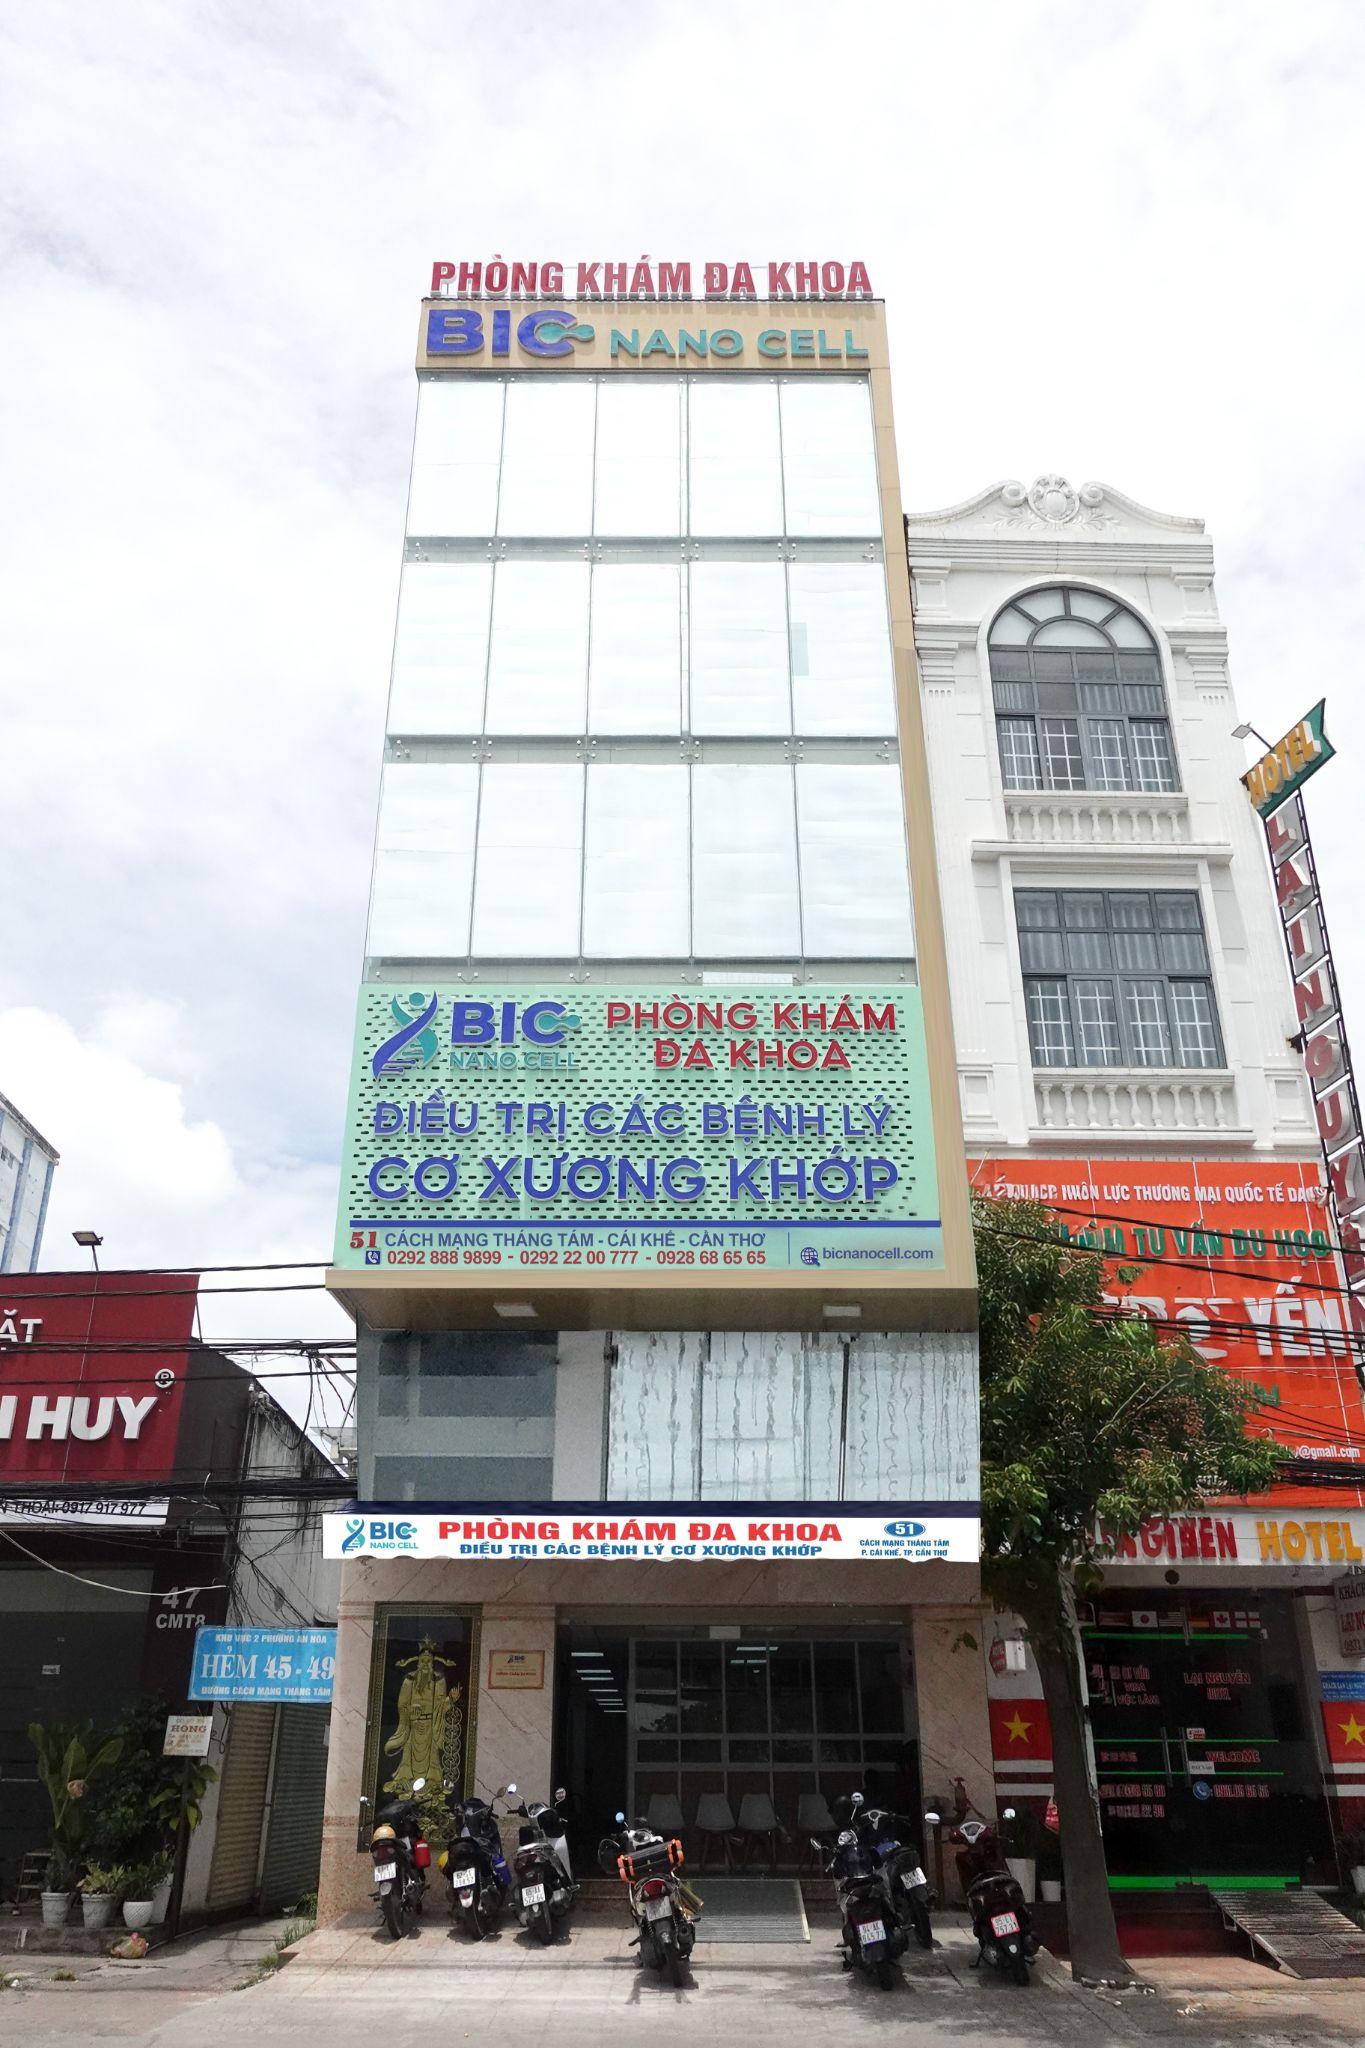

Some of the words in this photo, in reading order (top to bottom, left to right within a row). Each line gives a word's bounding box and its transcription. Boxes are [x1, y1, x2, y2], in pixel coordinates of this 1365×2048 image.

[430, 254, 564, 297] PHÒNG
[576, 254, 692, 298] KHÁM
[704, 262, 757, 298] ĐA
[768, 261, 873, 298] KHOA
[426, 309, 577, 357] BIC
[610, 329, 743, 357] NANO
[758, 329, 868, 358] CELL
[1247, 720, 1322, 808] HOTEL
[451, 1001, 568, 1047] BIC
[607, 994, 758, 1032] PHÒNG
[774, 994, 895, 1032] KHÁM
[450, 1052, 518, 1070] NANO
[524, 1052, 579, 1070] CELL
[653, 1038, 716, 1069] ĐA
[729, 1039, 852, 1070] KHOA
[374, 1088, 478, 1136] ĐIỀU
[495, 1103, 567, 1143] TRỊ
[583, 1093, 686, 1136] CÁC
[702, 1094, 825, 1145] BỆNH
[843, 1094, 892, 1137] LÝ
[368, 1153, 460, 1200] CƠ
[479, 1152, 706, 1201] XƯƠNG
[729, 1145, 898, 1202] KHỚP
[1103, 1183, 1130, 1203] LỰC
[1133, 1184, 1190, 1201] THƯƠNG
[1194, 1187, 1221, 1204] MẠI
[1225, 1182, 1264, 1203] QUỐC
[1266, 1182, 1284, 1202] TẾ
[350, 1231, 377, 1248] 51
[385, 1230, 433, 1247] CÁCH
[438, 1232, 488, 1250] MẠNG
[494, 1230, 552, 1247] THÁNG
[557, 1230, 594, 1247] TÁM
[607, 1230, 636, 1247] CÁI
[641, 1229, 676, 1246] KHẾ
[688, 1229, 724, 1247] CẦN
[729, 1232, 766, 1247] THƠ
[1172, 1219, 1224, 1256] VẤN
[1231, 1228, 1266, 1257] DU
[387, 1250, 426, 1264] 0292
[430, 1250, 459, 1264] 888
[463, 1250, 501, 1264] 9899
[520, 1250, 559, 1264] 0292
[563, 1250, 582, 1264] 22
[586, 1250, 605, 1264] 00
[609, 1250, 638, 1264] 777
[656, 1250, 695, 1264] 0928
[699, 1250, 718, 1264] 68
[723, 1250, 742, 1264] 65
[746, 1250, 766, 1264] 65
[822, 1247, 934, 1260] bicnanocell.com
[1243, 1275, 1347, 1357] YẾN
[25, 1396, 158, 1440] HUY
[62, 1502, 91, 1514] 0917
[96, 1502, 119, 1515] 917
[121, 1503, 147, 1516] 977
[370, 1522, 413, 1540] BIC
[439, 1518, 560, 1540] PHÒNG
[580, 1519, 676, 1541] KHÁM
[688, 1523, 736, 1541] ĐA
[748, 1523, 842, 1541] KHOA
[895, 1523, 914, 1535] 51
[459, 1541, 503, 1555] ĐIỀU
[508, 1544, 537, 1556] TRỊ
[544, 1542, 581, 1555] CÁC
[588, 1542, 638, 1557] BỆNH
[643, 1542, 664, 1555] LÝ
[671, 1544, 697, 1556] CƠ
[702, 1544, 766, 1556] XƯƠNG
[772, 1542, 822, 1556] KHỚP
[870, 1548, 882, 1556] CÁI
[882, 1539, 904, 1547] MẠNG
[1256, 1521, 1363, 1561] HOTEL
[162, 1586, 200, 1609] 47
[156, 1613, 206, 1629] CMT8
[254, 1634, 259, 1643] 2
[201, 1646, 258, 1679] HẺM
[263, 1655, 292, 1679] 45
[307, 1655, 336, 1680] 49
